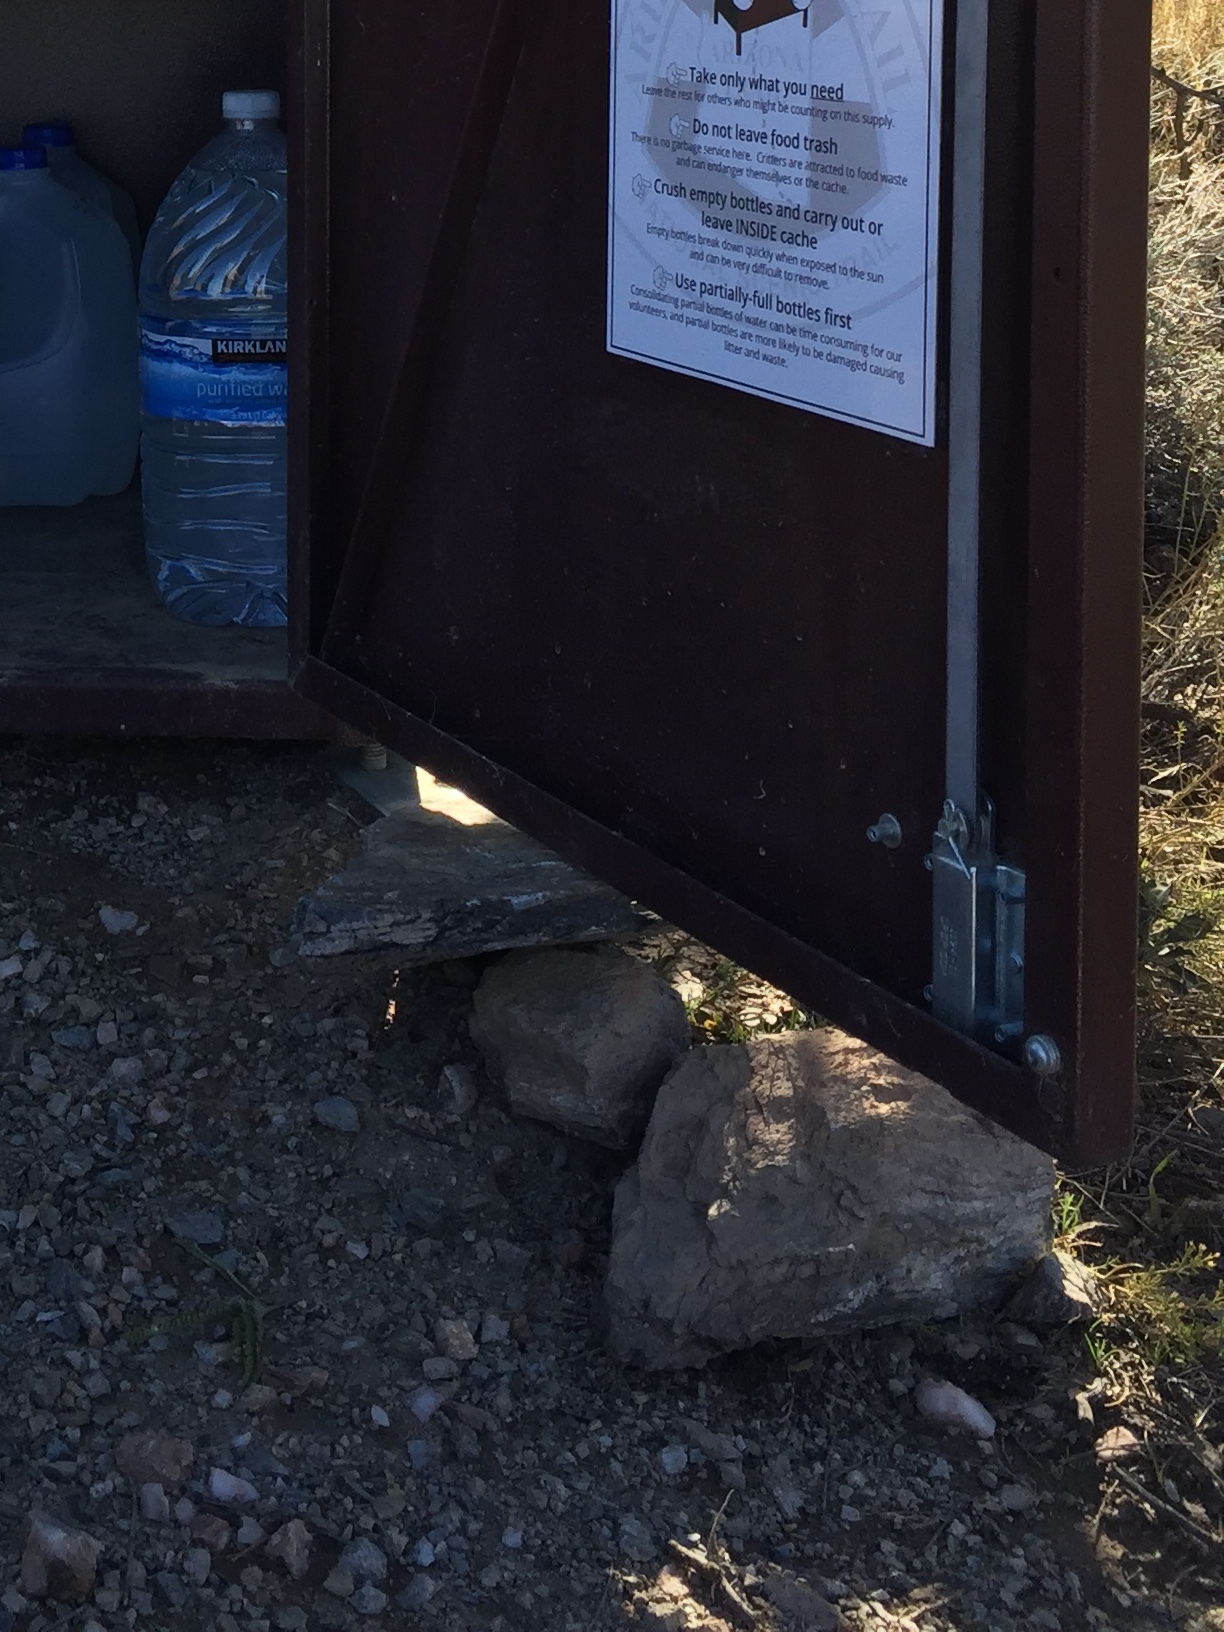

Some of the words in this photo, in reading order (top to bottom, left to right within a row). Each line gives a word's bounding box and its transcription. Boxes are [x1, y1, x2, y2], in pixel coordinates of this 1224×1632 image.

[688, 66, 717, 85] Take
[719, 71, 746, 93] only
[748, 73, 780, 93] what
[783, 80, 807, 99] you
[810, 82, 845, 102] need
[692, 118, 709, 136] Do
[711, 124, 733, 140] not
[735, 123, 768, 145] leave
[770, 128, 800, 150] food
[803, 135, 838, 155] trash
[653, 178, 687, 199] Crush
[689, 186, 727, 211] empty
[729, 191, 773, 216] bottles
[775, 202, 801, 221] and
[803, 208, 839, 232] carry
[841, 215, 865, 234] out
[867, 220, 884, 236] or
[701, 210, 733, 233] leave
[735, 218, 777, 242] INSIDE
[780, 229, 818, 250] cache
[675, 272, 697, 292] Use
[699, 281, 773, 311] partially-full
[775, 295, 821, 323] bottles
[824, 306, 853, 330] first
[196, 379, 265, 399] purified
